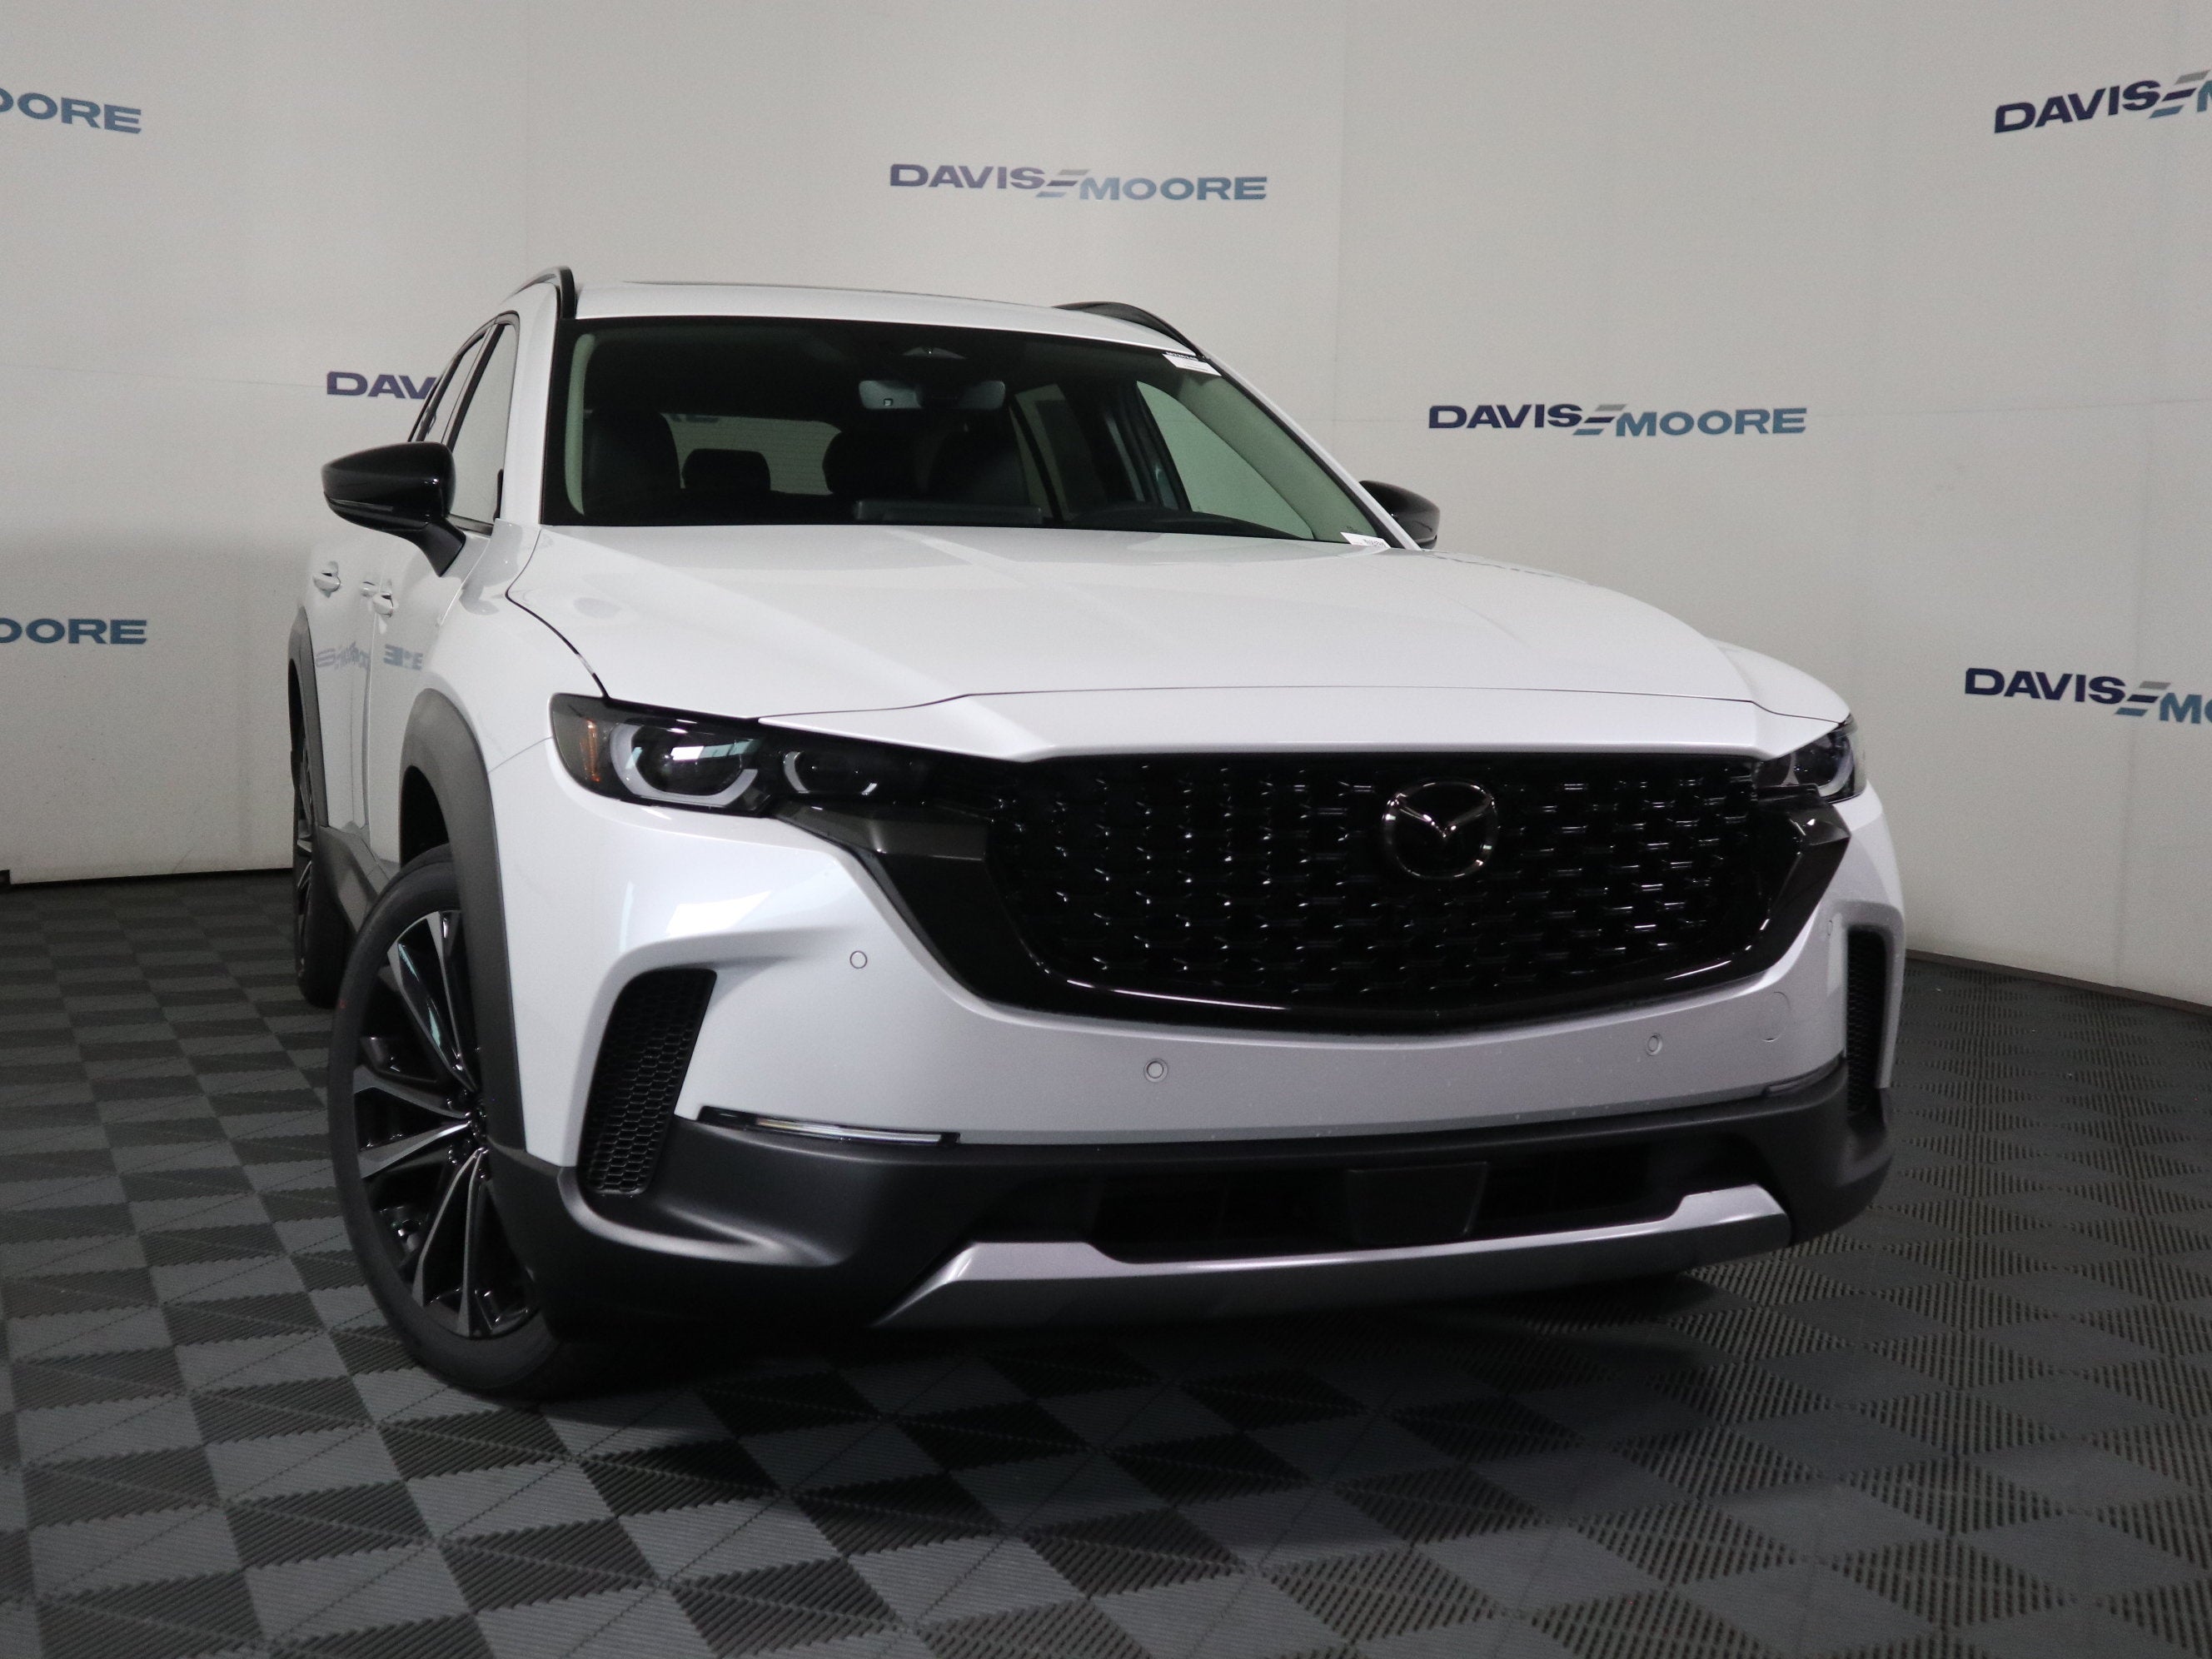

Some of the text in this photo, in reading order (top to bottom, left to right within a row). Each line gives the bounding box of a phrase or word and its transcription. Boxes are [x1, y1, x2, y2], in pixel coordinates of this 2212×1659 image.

[1995, 80, 2160, 134] DAVIS
[890, 163, 1268, 201] DAVIS MOORE
[326, 371, 437, 400] DAV
[1428, 404, 1806, 436] DAVIS MOORE
[1965, 668, 2212, 725] DAVIS M
